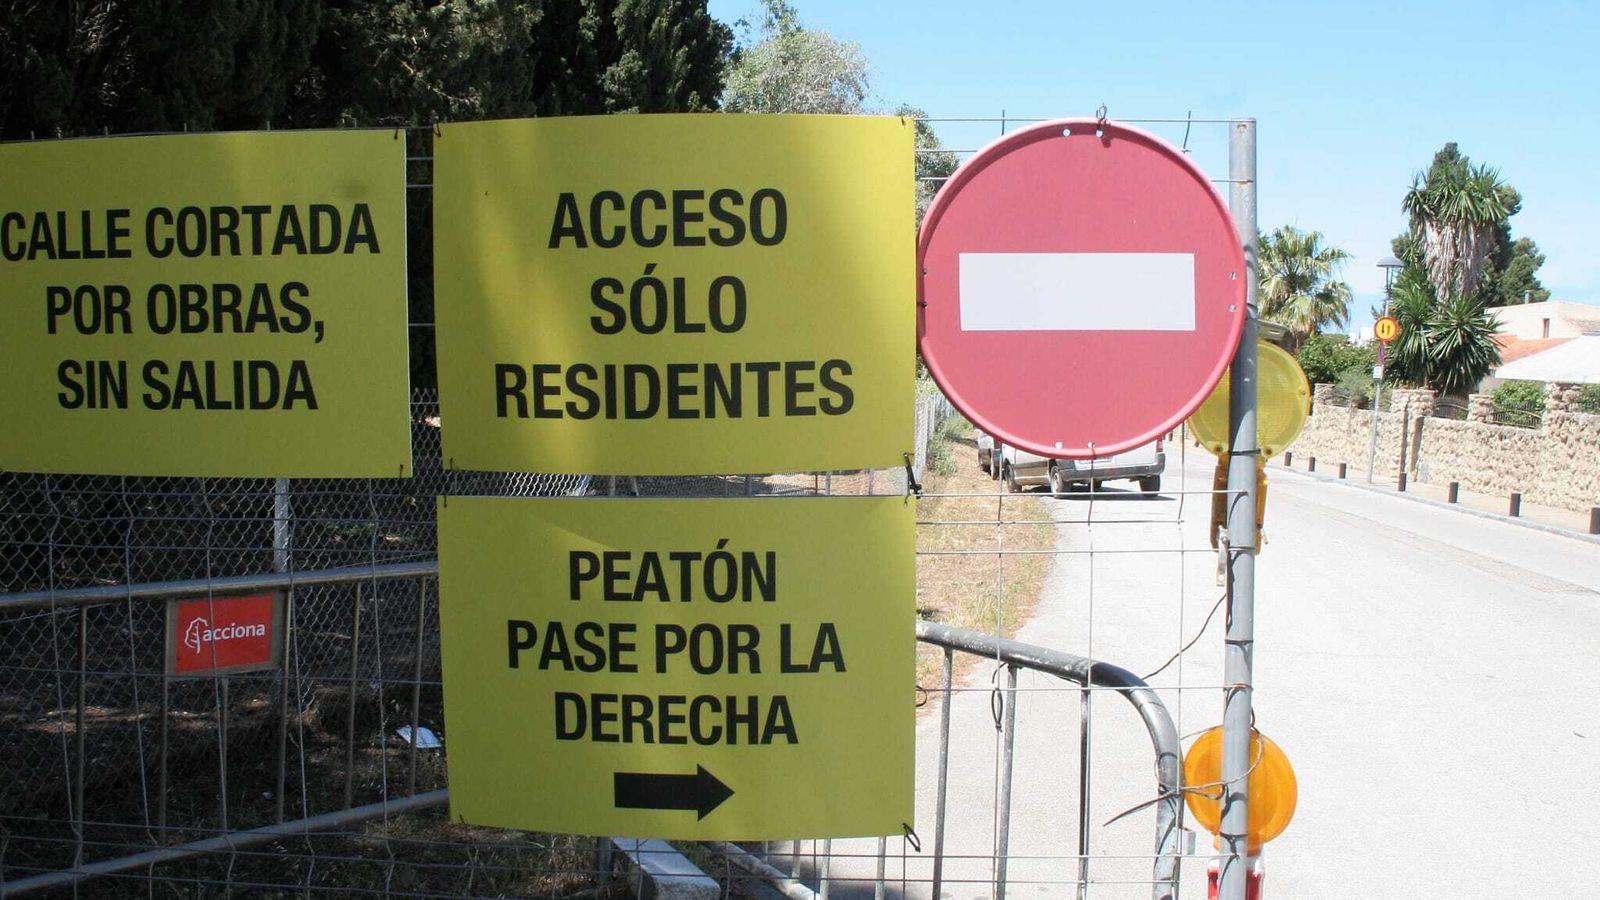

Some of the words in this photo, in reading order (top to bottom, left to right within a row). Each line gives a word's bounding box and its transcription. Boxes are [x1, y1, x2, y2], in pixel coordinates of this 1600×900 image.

[1, 209, 131, 260] CALLE
[146, 204, 380, 258] CORTADA
[548, 189, 787, 248] ACCESO
[47, 286, 132, 335] POR
[147, 282, 324, 343] OBRAS,
[590, 263, 746, 335] SÓLO
[58, 360, 128, 409] SIN
[143, 360, 318, 410] SALIDA
[495, 360, 853, 420] RESIDENTES
[570, 539, 776, 603] PEATÓN
[203, 622, 265, 642] acciona
[508, 620, 637, 672] PASE
[656, 623, 761, 675] POR
[780, 623, 846, 673] LA
[555, 692, 798, 745] DERECHA
